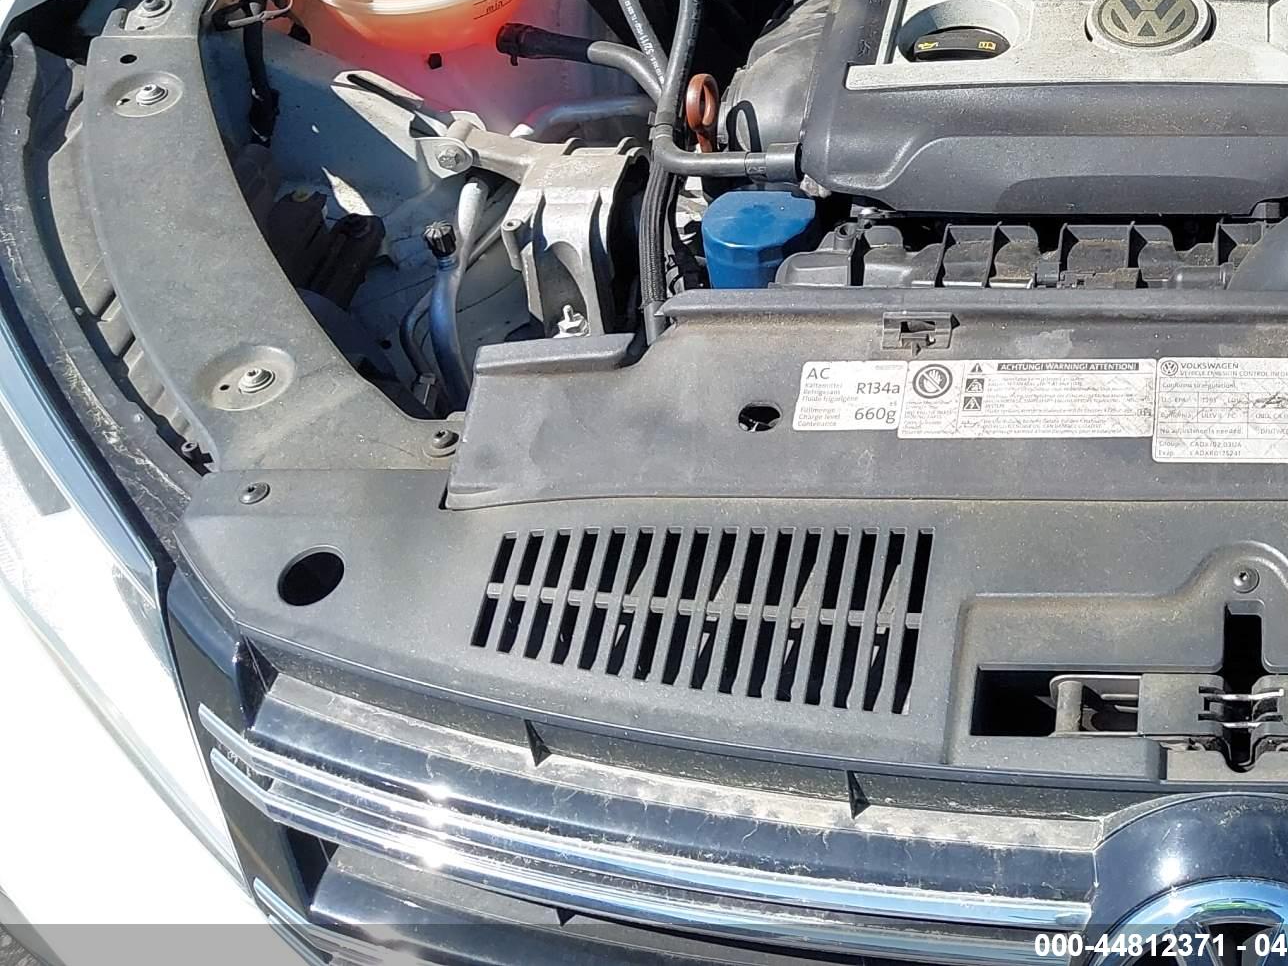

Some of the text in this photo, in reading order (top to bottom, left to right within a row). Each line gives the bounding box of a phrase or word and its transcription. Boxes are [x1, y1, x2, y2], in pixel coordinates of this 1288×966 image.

[1000, 362, 1137, 371] ACHTUNG! WARNING! ATTENTION!
[806, 367, 831, 380] AC
[856, 382, 900, 395] R134a
[854, 407, 896, 424] 660g
